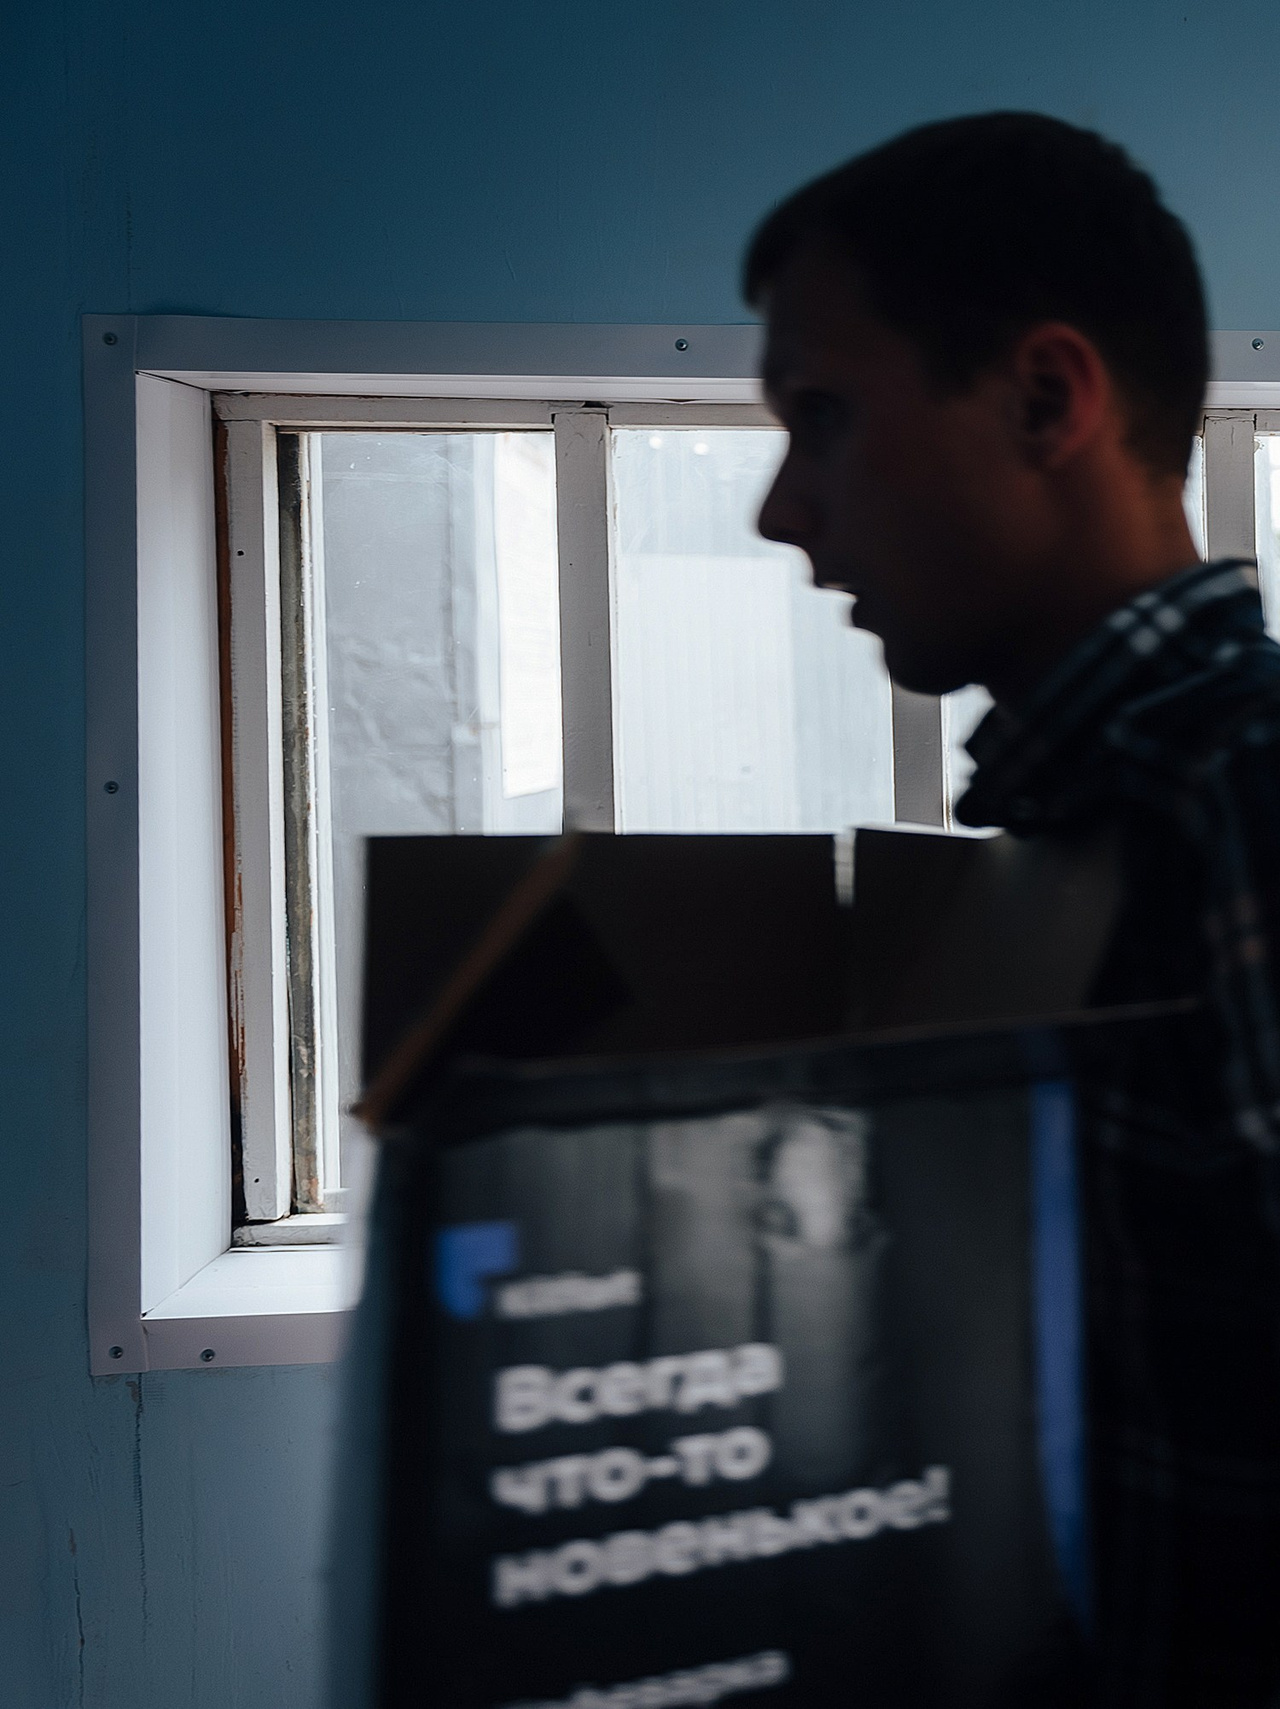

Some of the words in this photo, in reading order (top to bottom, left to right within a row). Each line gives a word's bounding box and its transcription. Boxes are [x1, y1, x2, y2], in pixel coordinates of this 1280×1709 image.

[496, 1343, 784, 1433] Всегда
[493, 1426, 771, 1513] что-то
[495, 1465, 953, 1606] новенькое!
